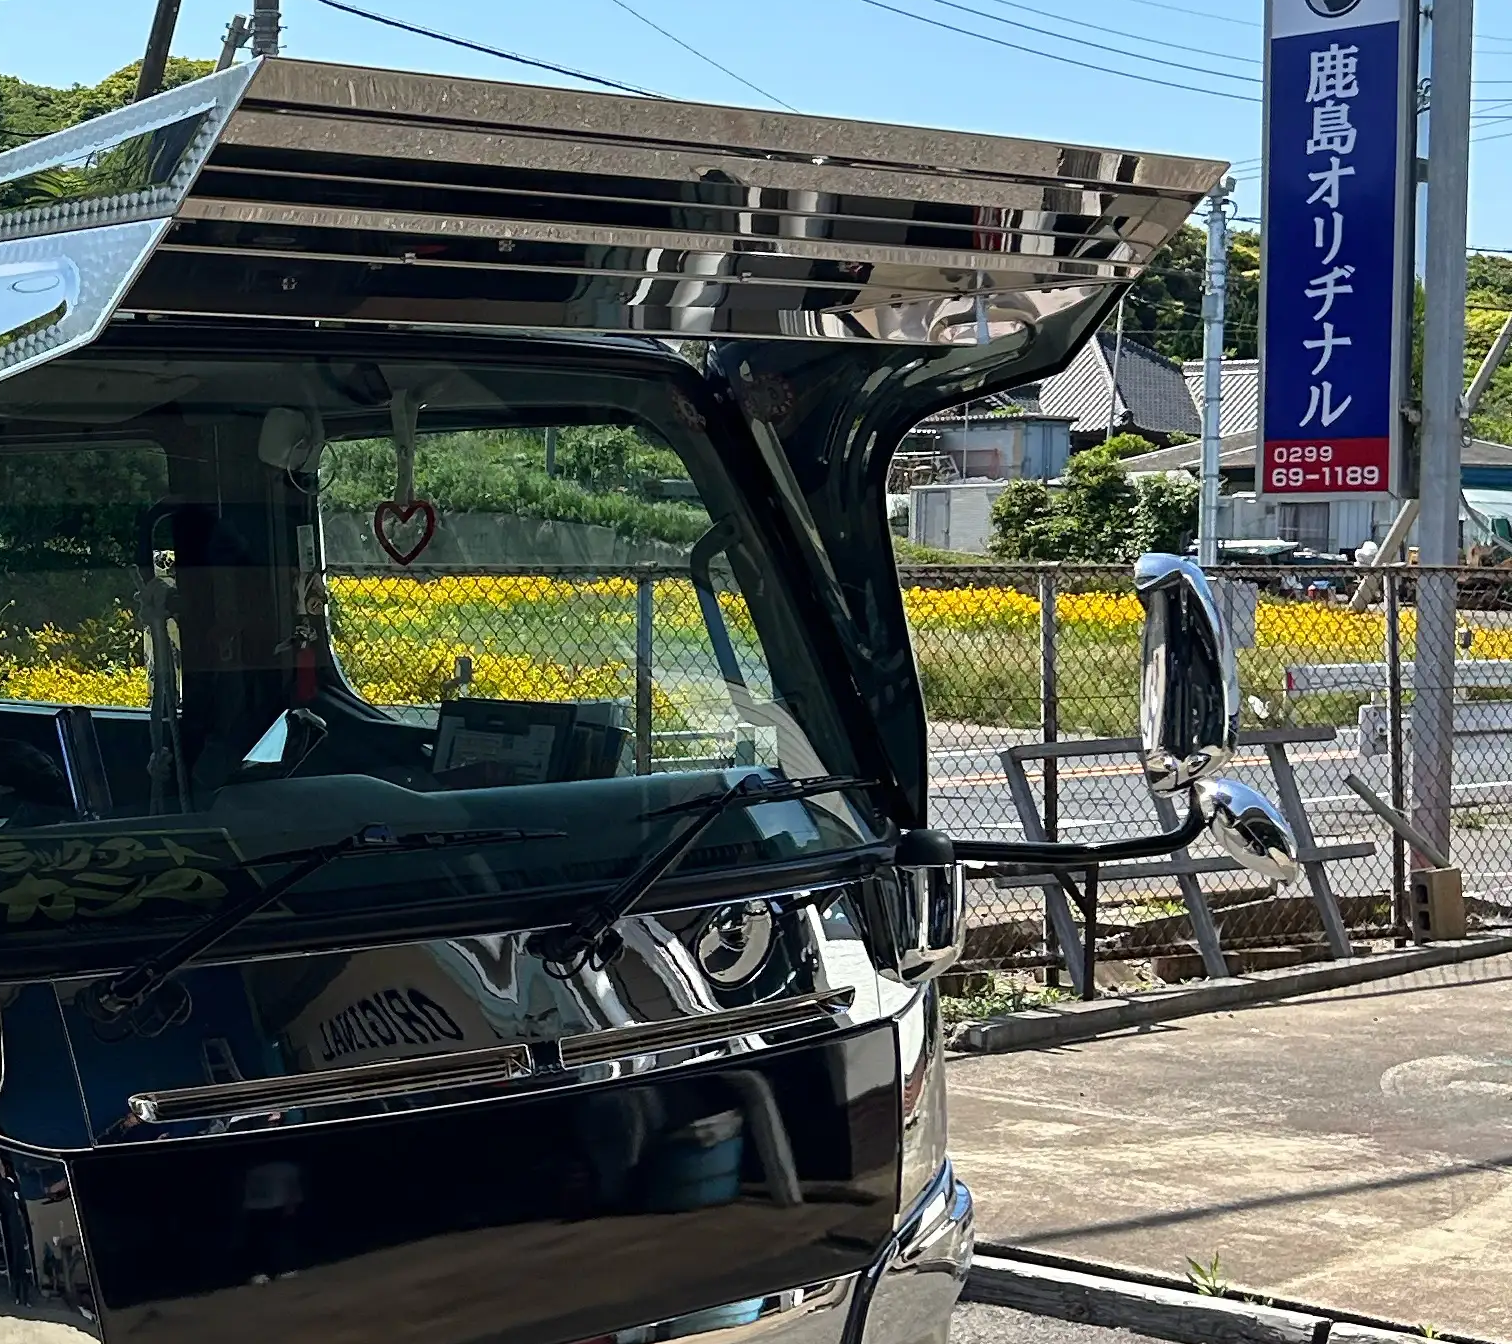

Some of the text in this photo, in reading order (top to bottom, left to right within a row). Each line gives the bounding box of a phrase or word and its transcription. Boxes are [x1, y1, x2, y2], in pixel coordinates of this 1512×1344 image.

[1299, 43, 1360, 428] 鹿島オリヂナル
[1273, 445, 1333, 463] 0299
[1272, 465, 1379, 487] 69-1189
